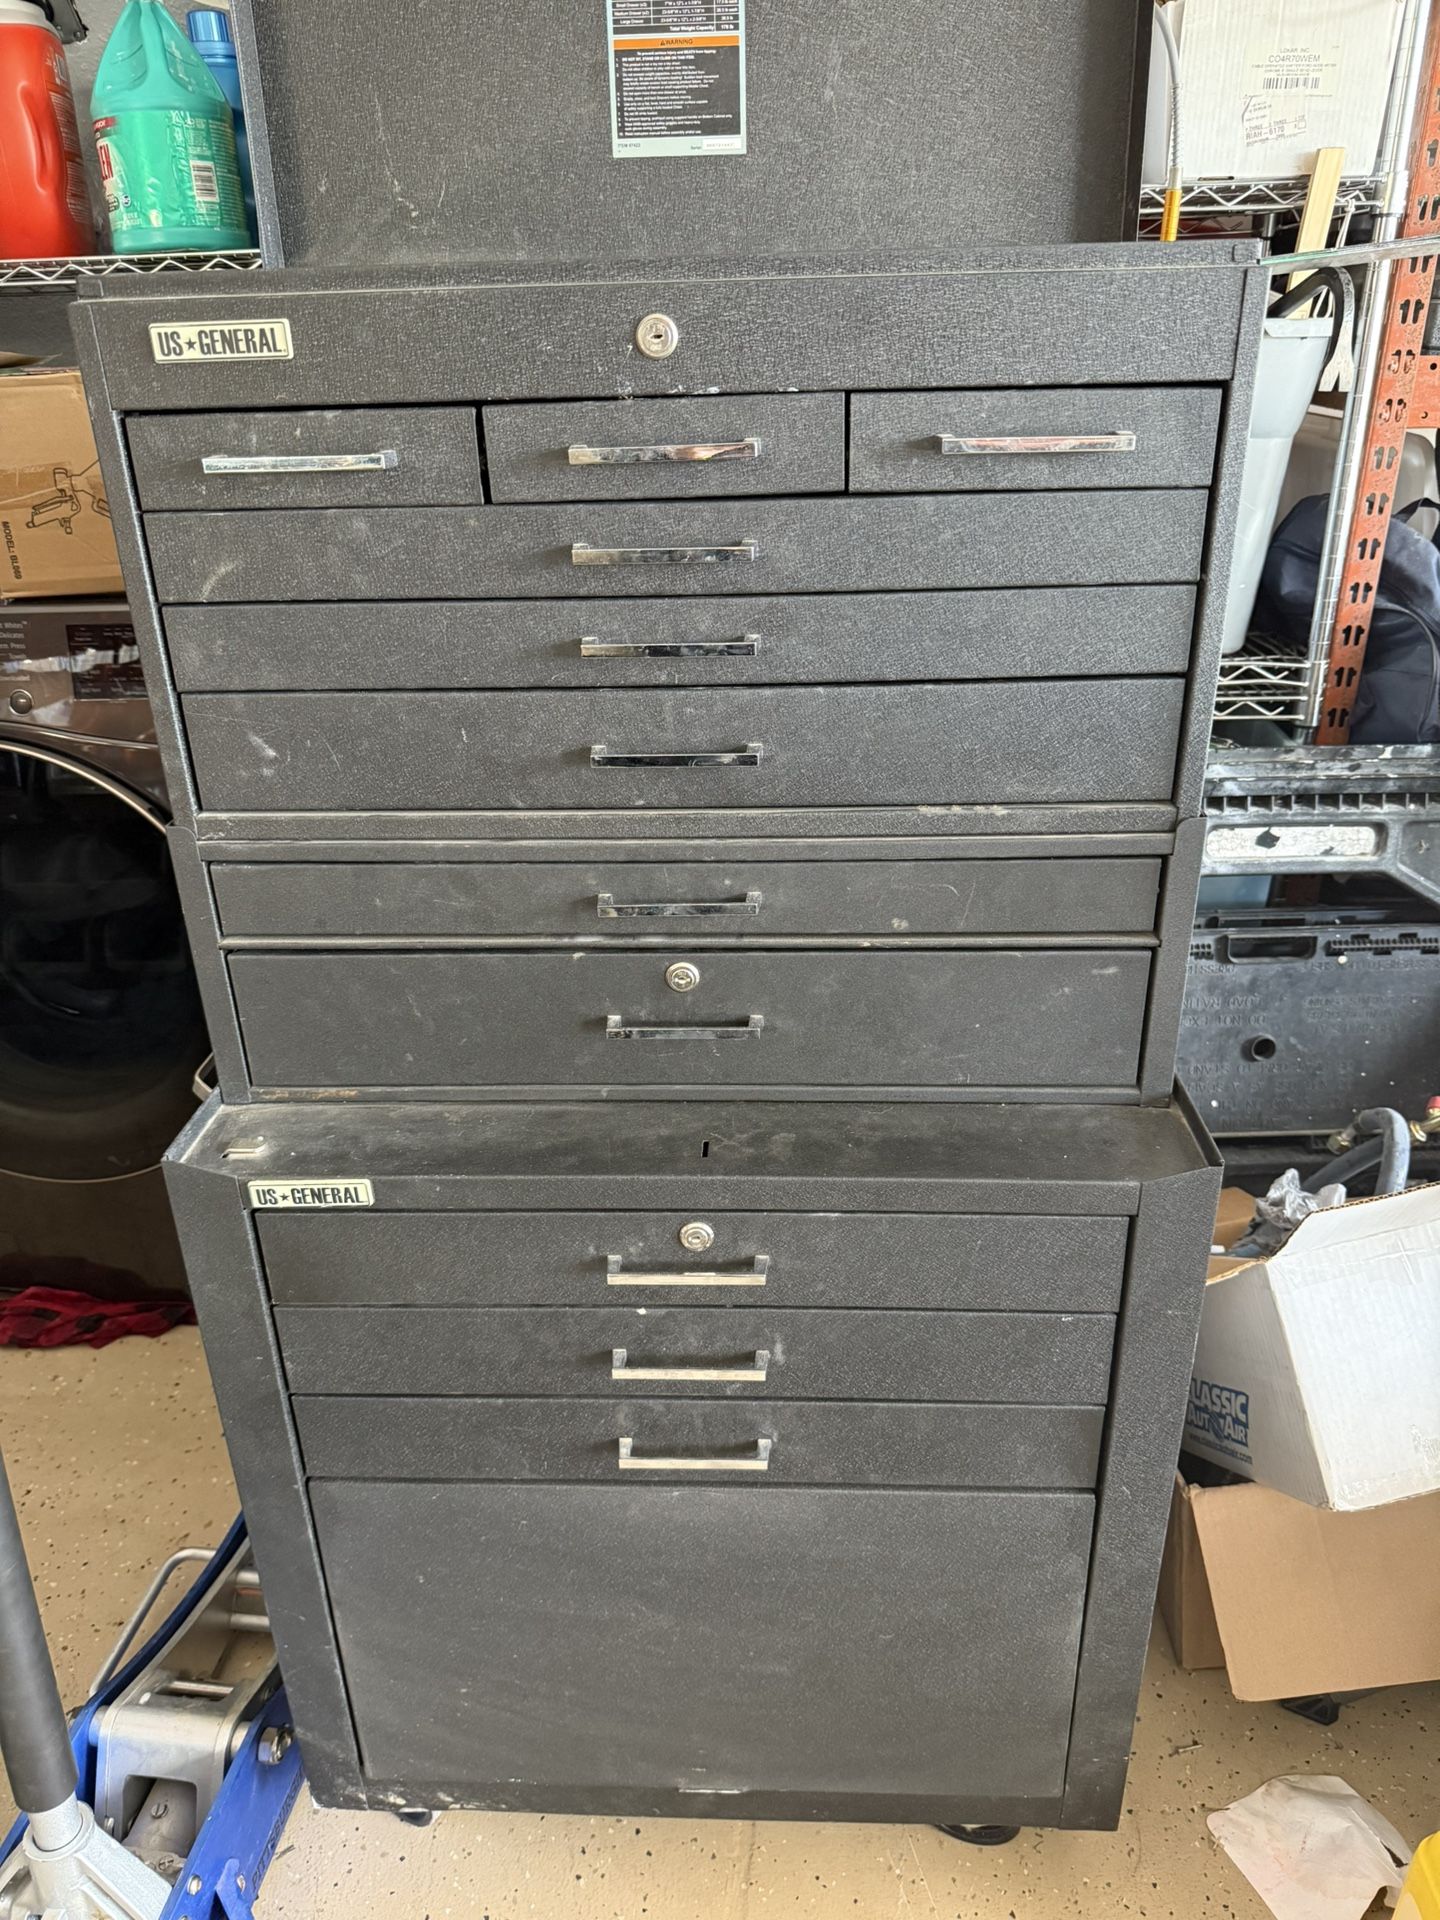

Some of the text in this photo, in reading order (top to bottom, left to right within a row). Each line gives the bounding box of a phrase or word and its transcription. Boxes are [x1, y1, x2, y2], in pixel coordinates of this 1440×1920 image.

[665, 38, 693, 46] WARNING
[157, 327, 283, 357] US GENERAL
[2, 521, 15, 553] MODEL:
[256, 1186, 365, 1205] US GENERAL
[1189, 1379, 1248, 1424] LASSIC
